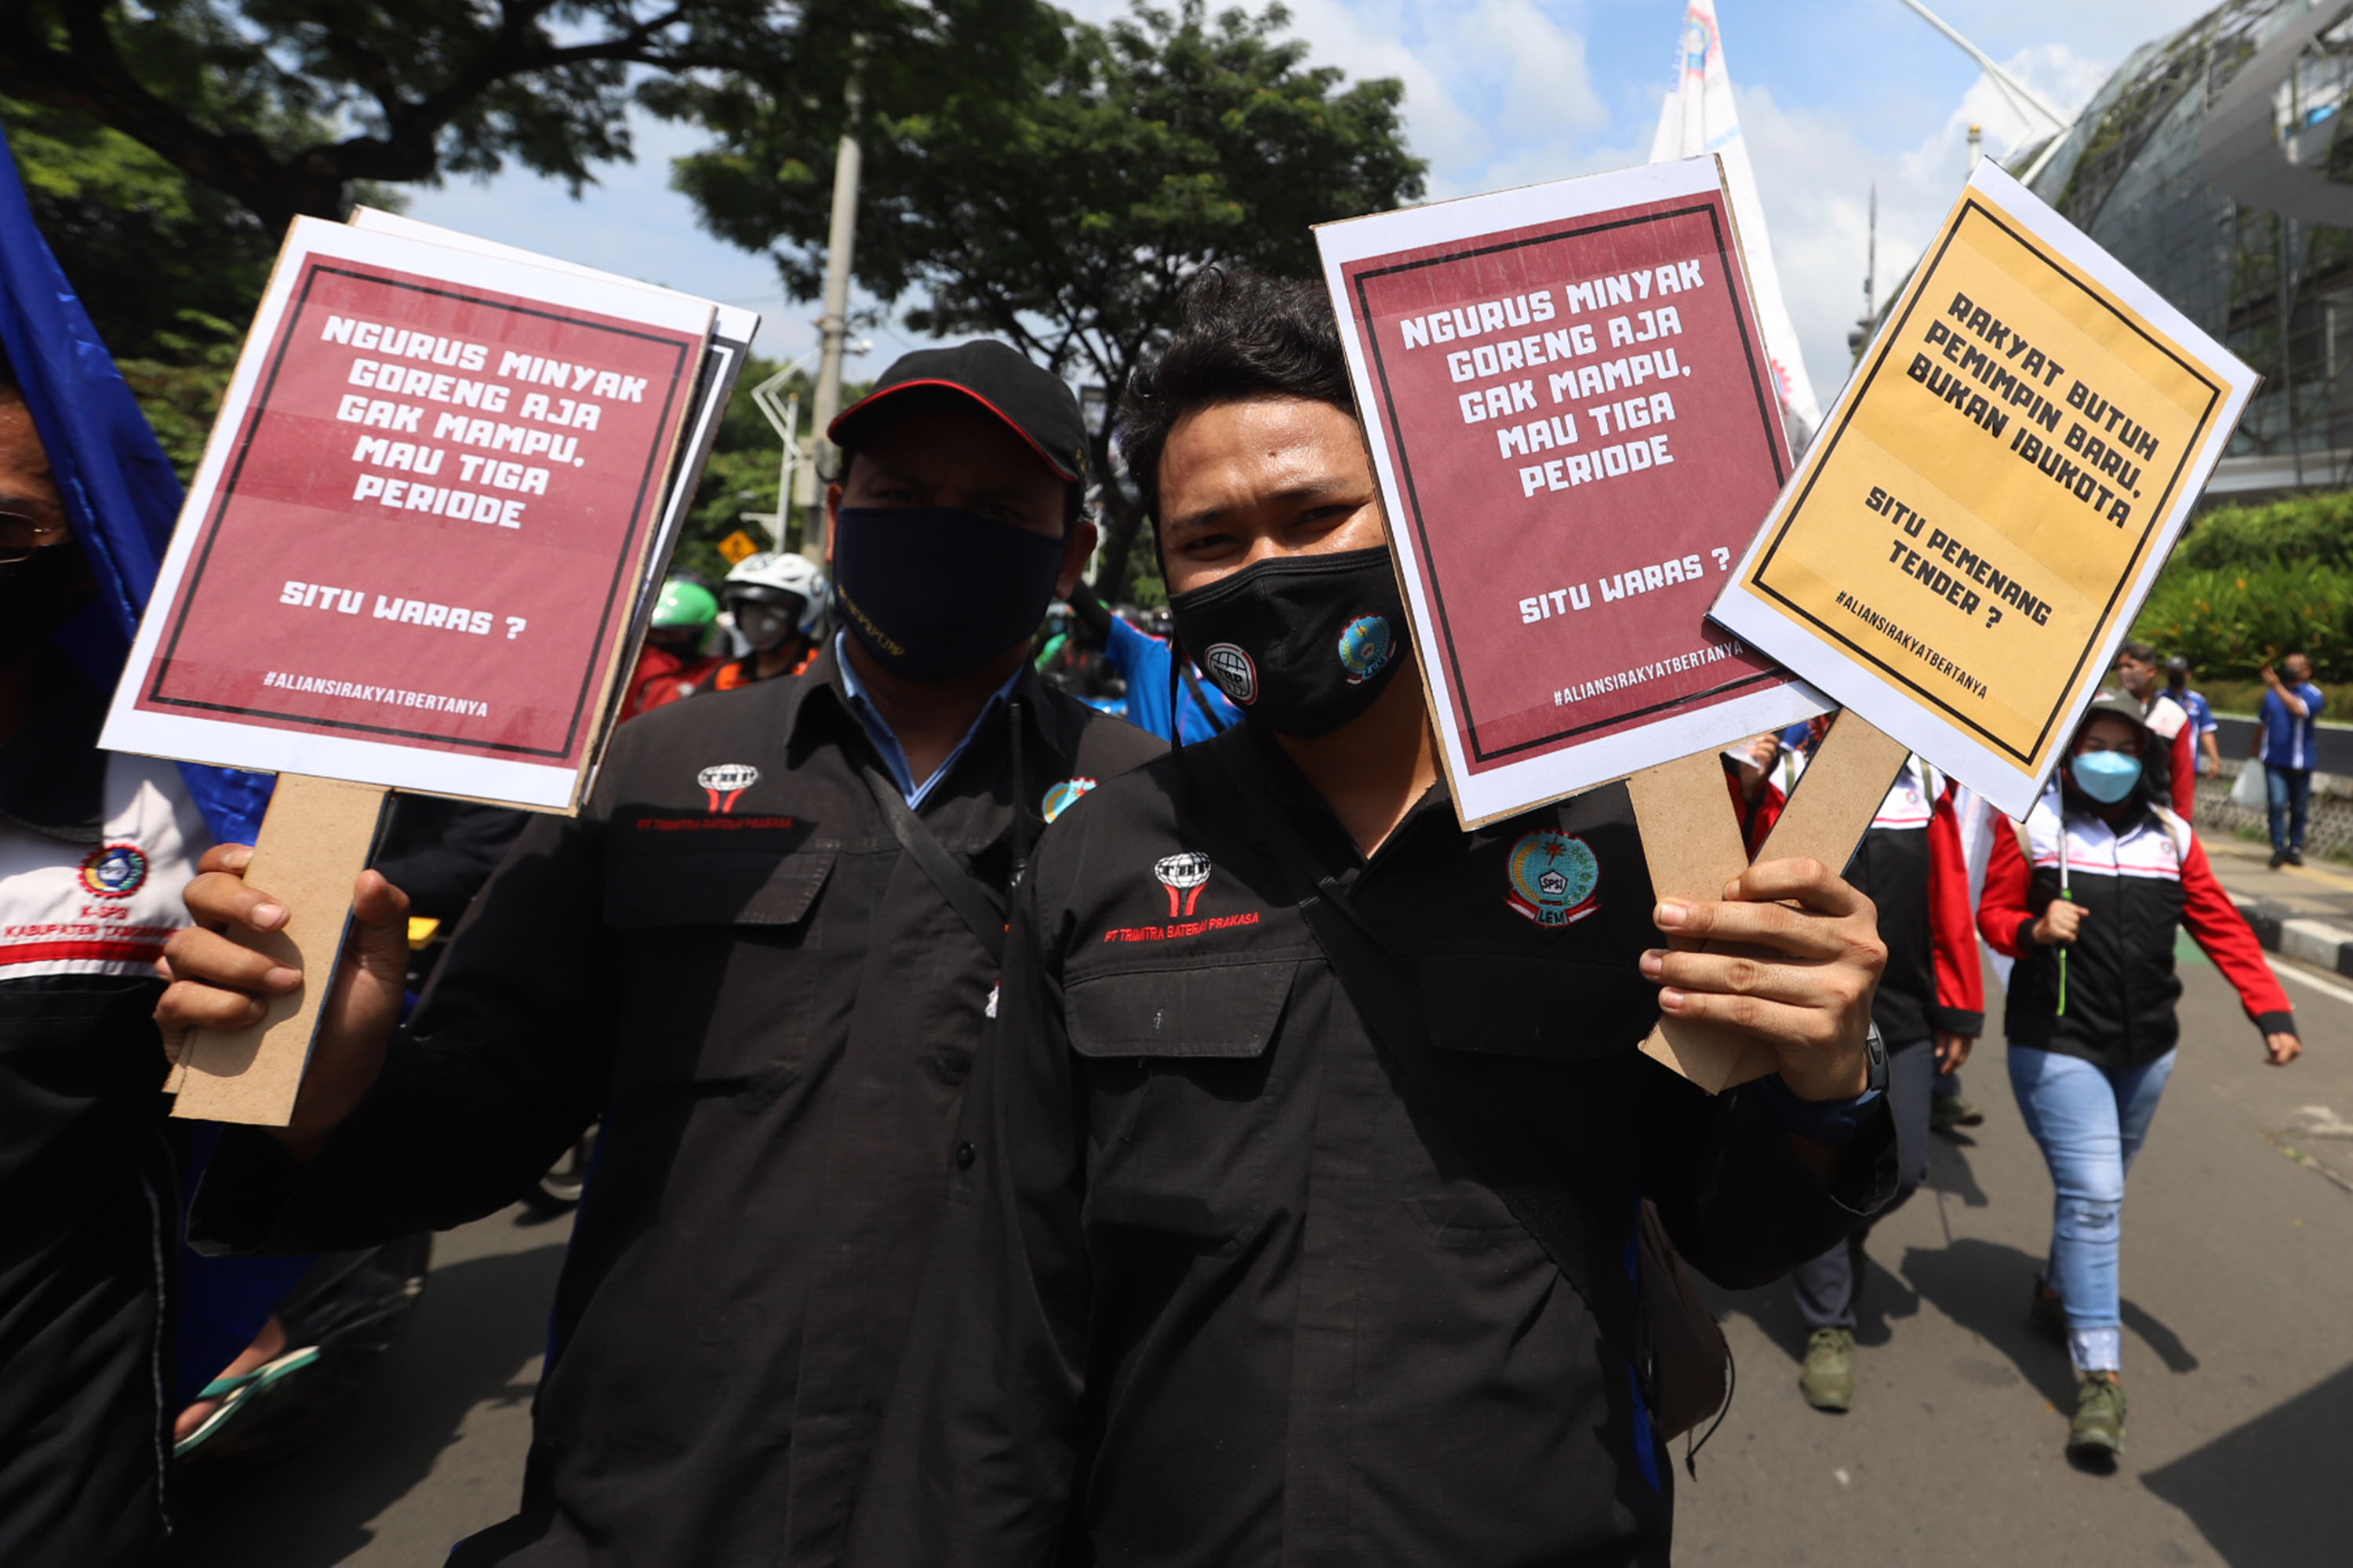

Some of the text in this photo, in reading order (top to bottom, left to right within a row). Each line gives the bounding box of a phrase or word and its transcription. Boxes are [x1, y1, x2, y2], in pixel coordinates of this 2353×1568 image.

[1400, 259, 1704, 350] NGURUS MINYAK
[320, 315, 649, 403] NGURUS MINYAK
[1447, 306, 1682, 383] GORENG AJA
[1925, 320, 2062, 432] PEMIMPIN
[1948, 293, 2158, 461] RAKYAT BUTUH
[336, 394, 426, 433] GAK
[347, 358, 602, 431] GORENG AJA
[1459, 380, 1537, 424] GAK
[1497, 391, 1675, 459] MAU TIGA
[351, 435, 551, 496] MAU TIGA
[1518, 435, 1674, 497] PERIODE
[1907, 353, 2130, 528] BUKAN IBUKOTA
[353, 474, 526, 529] PERIODE
[1519, 547, 1730, 624] SITU WARAS ?
[1866, 487, 2051, 625] SITU PEMENANG
[1890, 540, 2002, 628] TENDER ?
[279, 580, 527, 639] SITU WARAS ?
[1554, 640, 1744, 706] #ALIANSIRAKYATBERTANYA
[1836, 591, 1986, 697] #ALIANSIRAKYATBERTANYA
[264, 671, 487, 717] #ALIANSIRAKYATBERTANYA
[1538, 909, 1566, 924] LEM
[1542, 878, 1564, 890] SPSI
[1104, 930, 1118, 943] PT
[1209, 911, 1259, 930] PRAKASA
